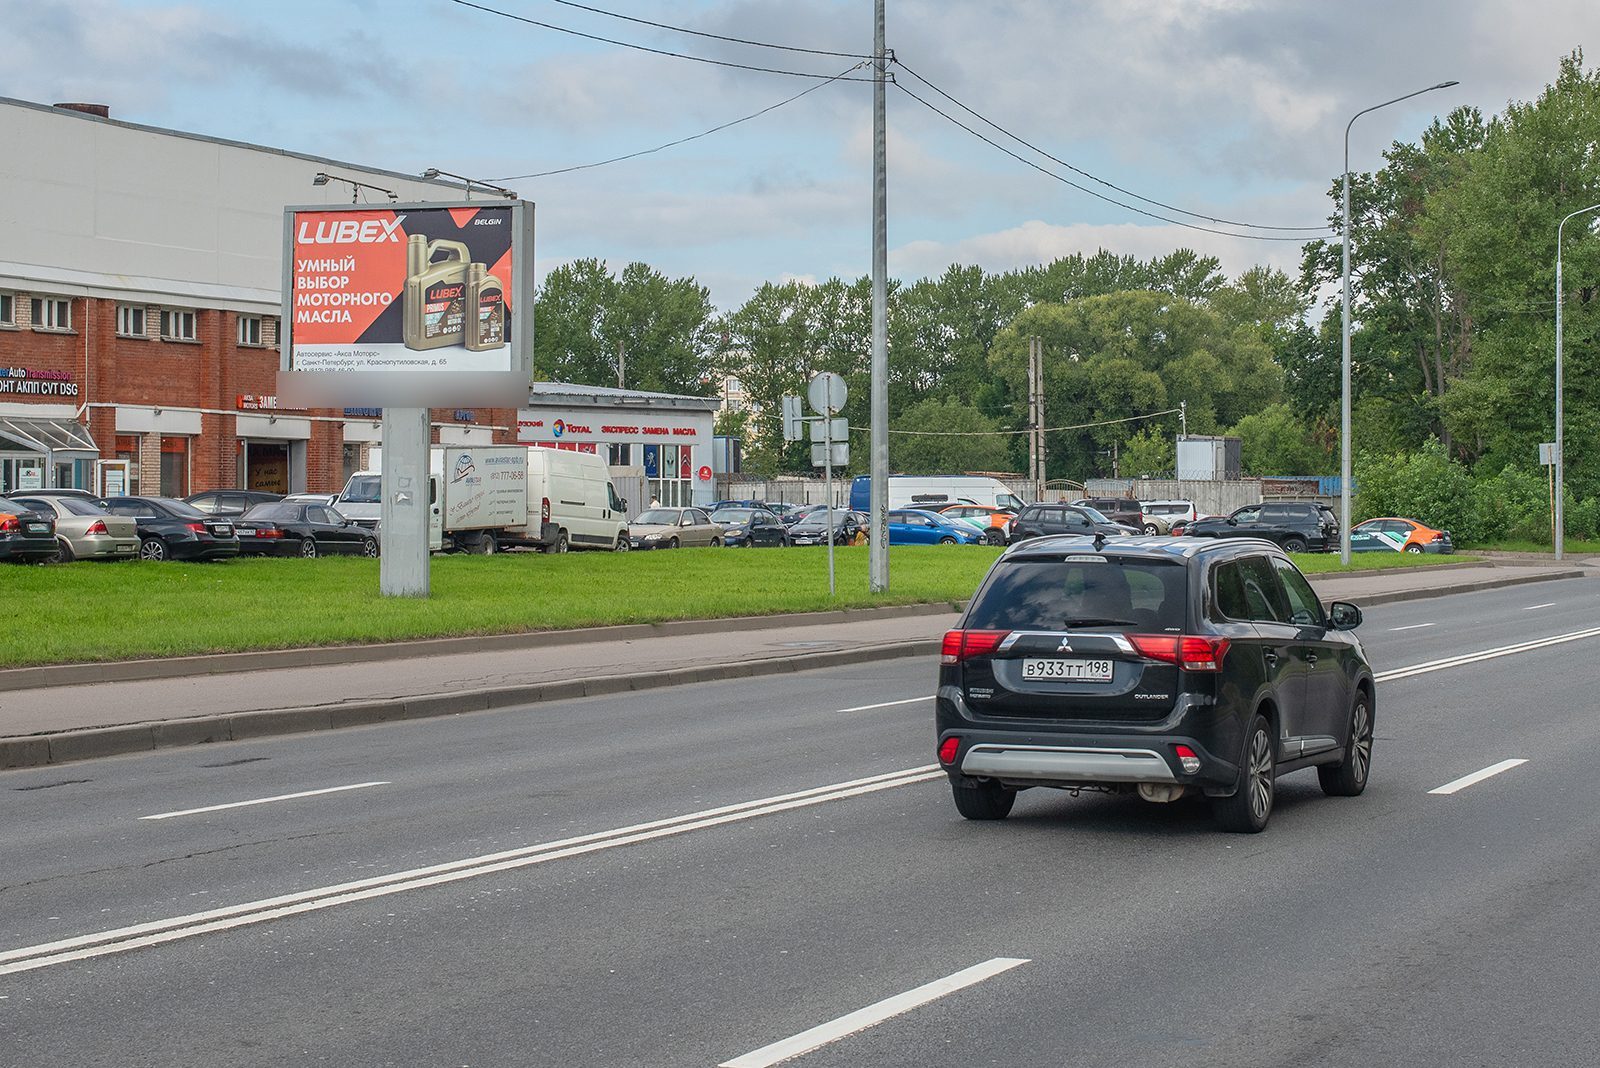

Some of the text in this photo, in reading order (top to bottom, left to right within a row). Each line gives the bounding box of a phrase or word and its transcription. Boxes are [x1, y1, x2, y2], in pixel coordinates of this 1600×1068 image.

[298, 215, 407, 244] LUBEX
[297, 255, 355, 272] УМНЫЙ
[297, 276, 349, 289] ВЫБОР
[297, 292, 393, 306] МОТОРНОГО
[430, 285, 463, 300] LUBEX
[297, 310, 353, 323] МАСЛА
[16, 381, 40, 394] АКПП
[41, 382, 59, 395] CVT
[60, 383, 78, 396] DSG
[601, 426, 697, 436] ЭКСПРЕСС ЗАМЕНА МАСЛА
[1027, 661, 1109, 676] В933ТТ 198
